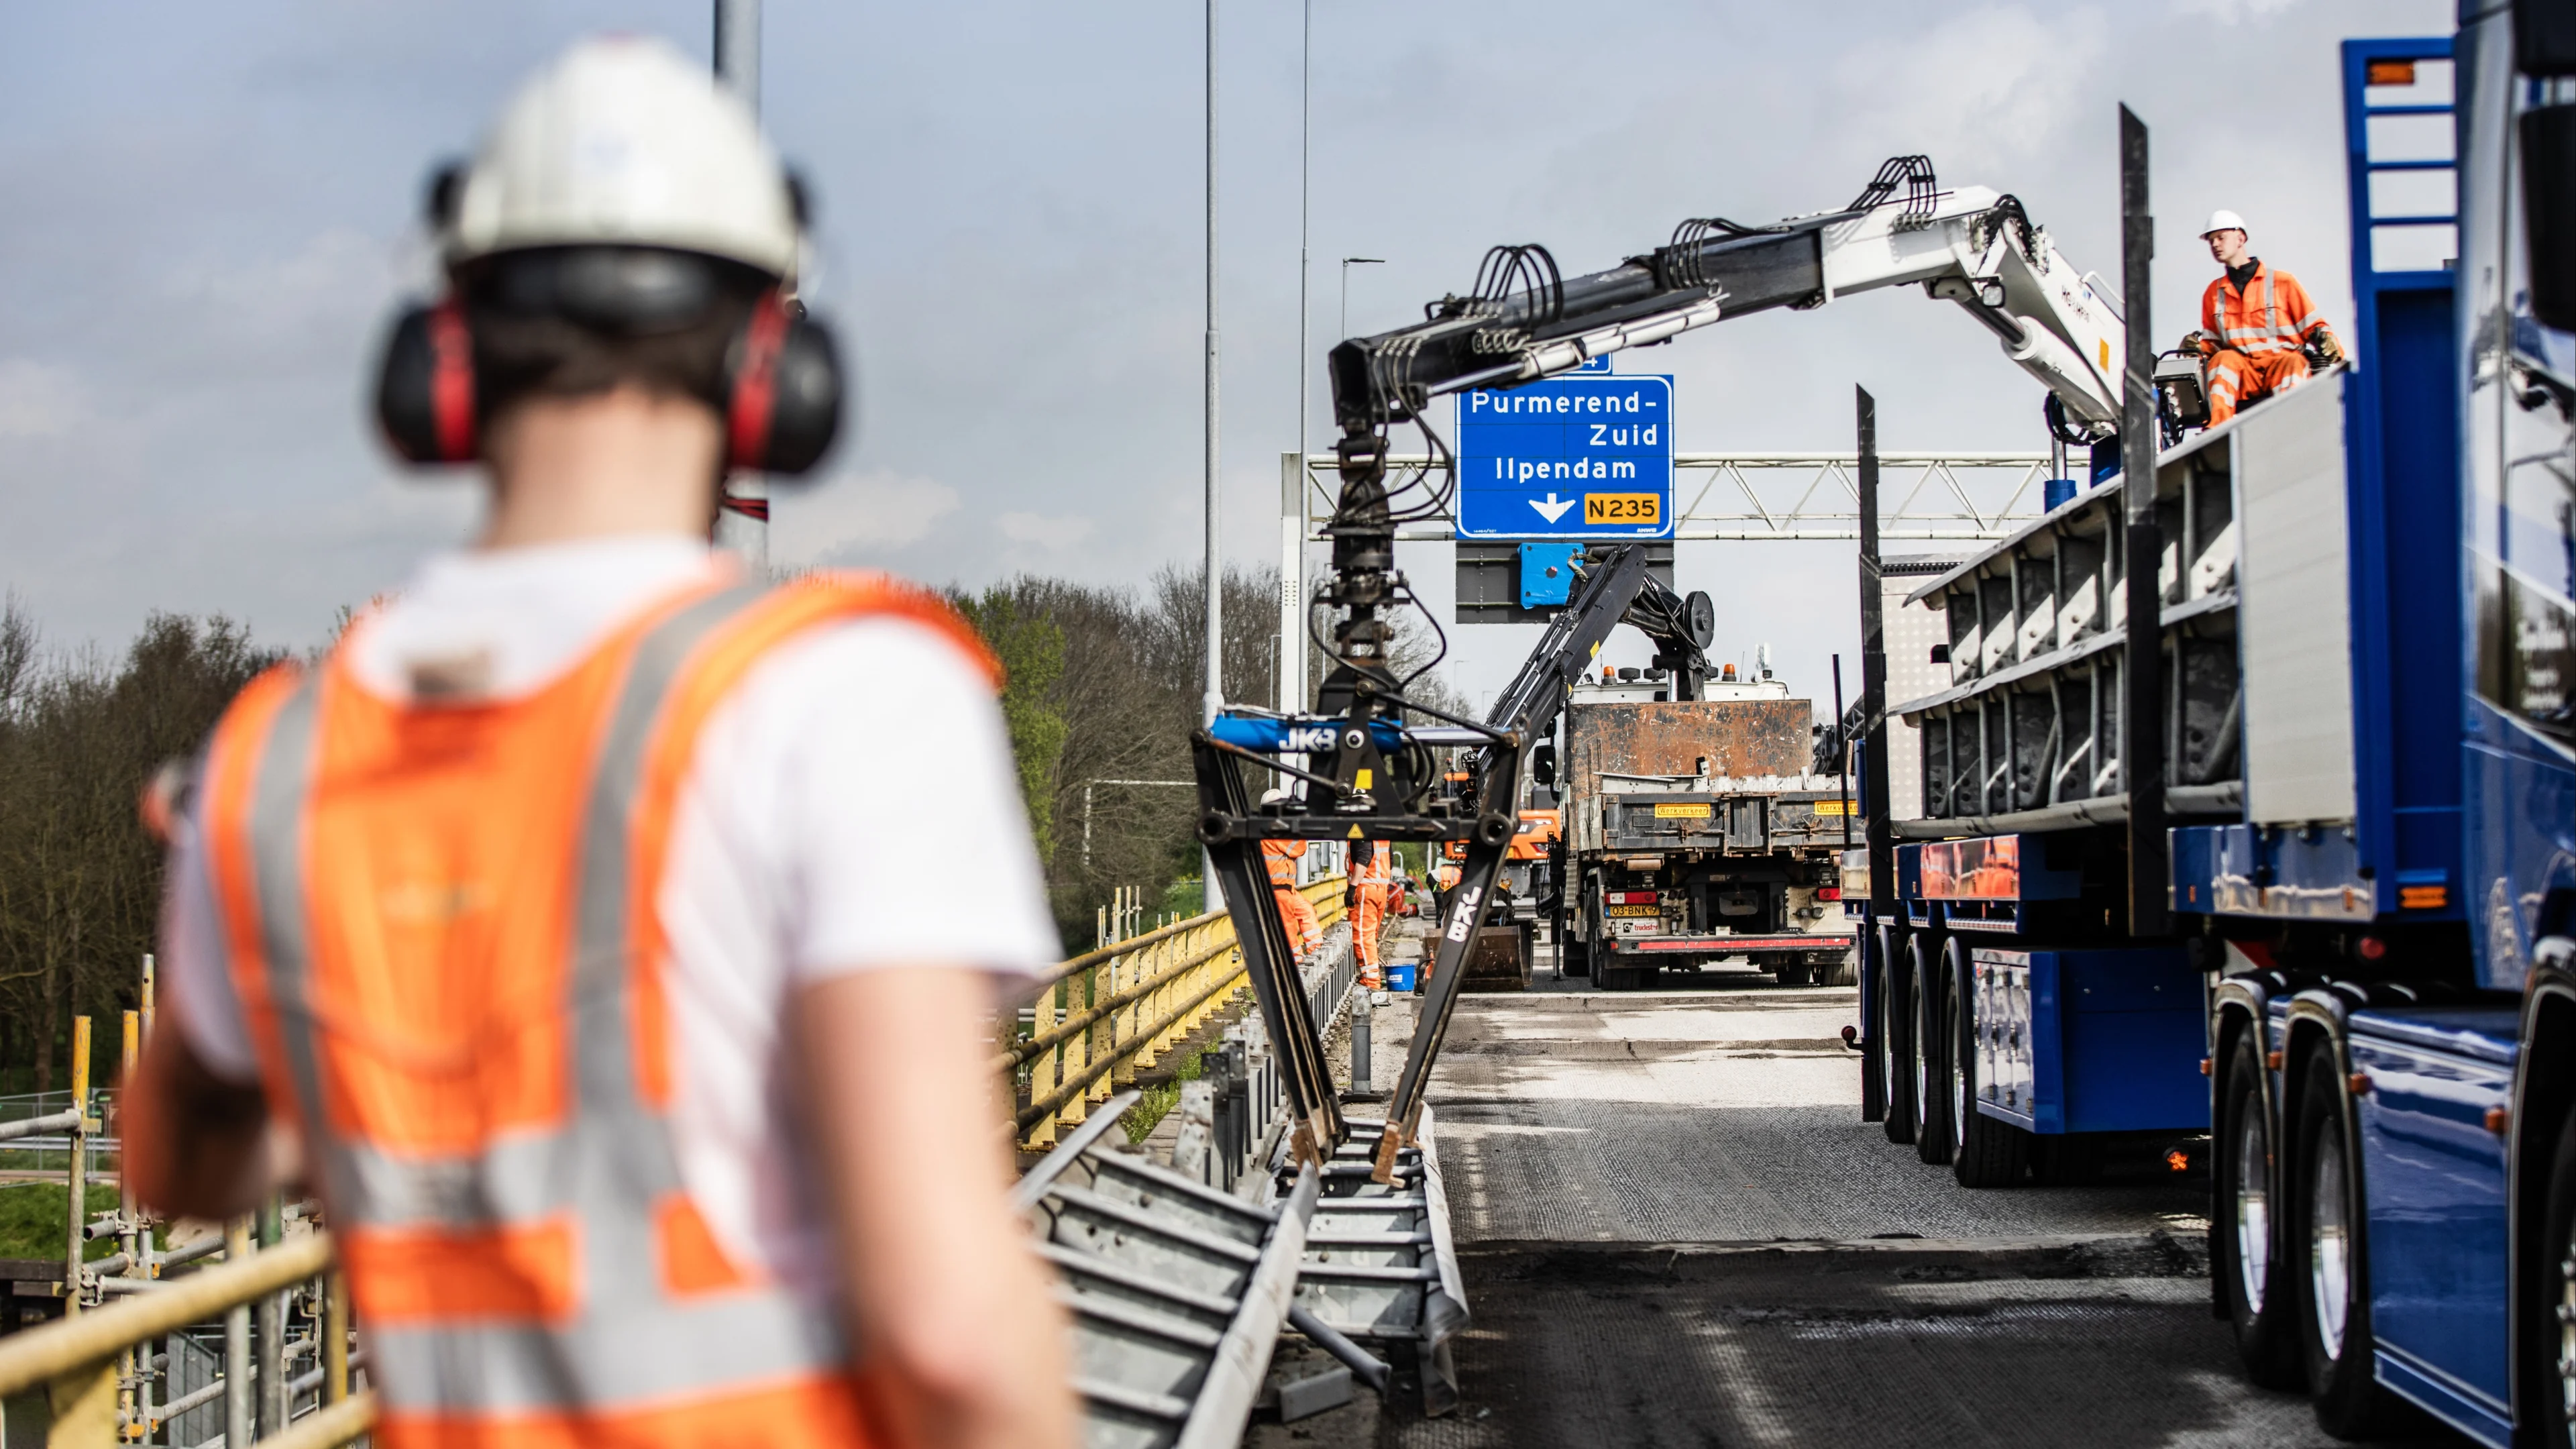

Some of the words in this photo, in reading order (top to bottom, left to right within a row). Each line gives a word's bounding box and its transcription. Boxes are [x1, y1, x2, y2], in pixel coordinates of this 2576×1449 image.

[1472, 391, 1656, 413] Purmerend-
[1590, 424, 1657, 445] Zuid
[1497, 457, 1635, 484] Ilpendam
[1589, 500, 1655, 518] N235
[1279, 728, 1337, 752] JKB
[1447, 886, 1482, 942] JKB
[1613, 906, 1656, 915] 03-BNK-9
